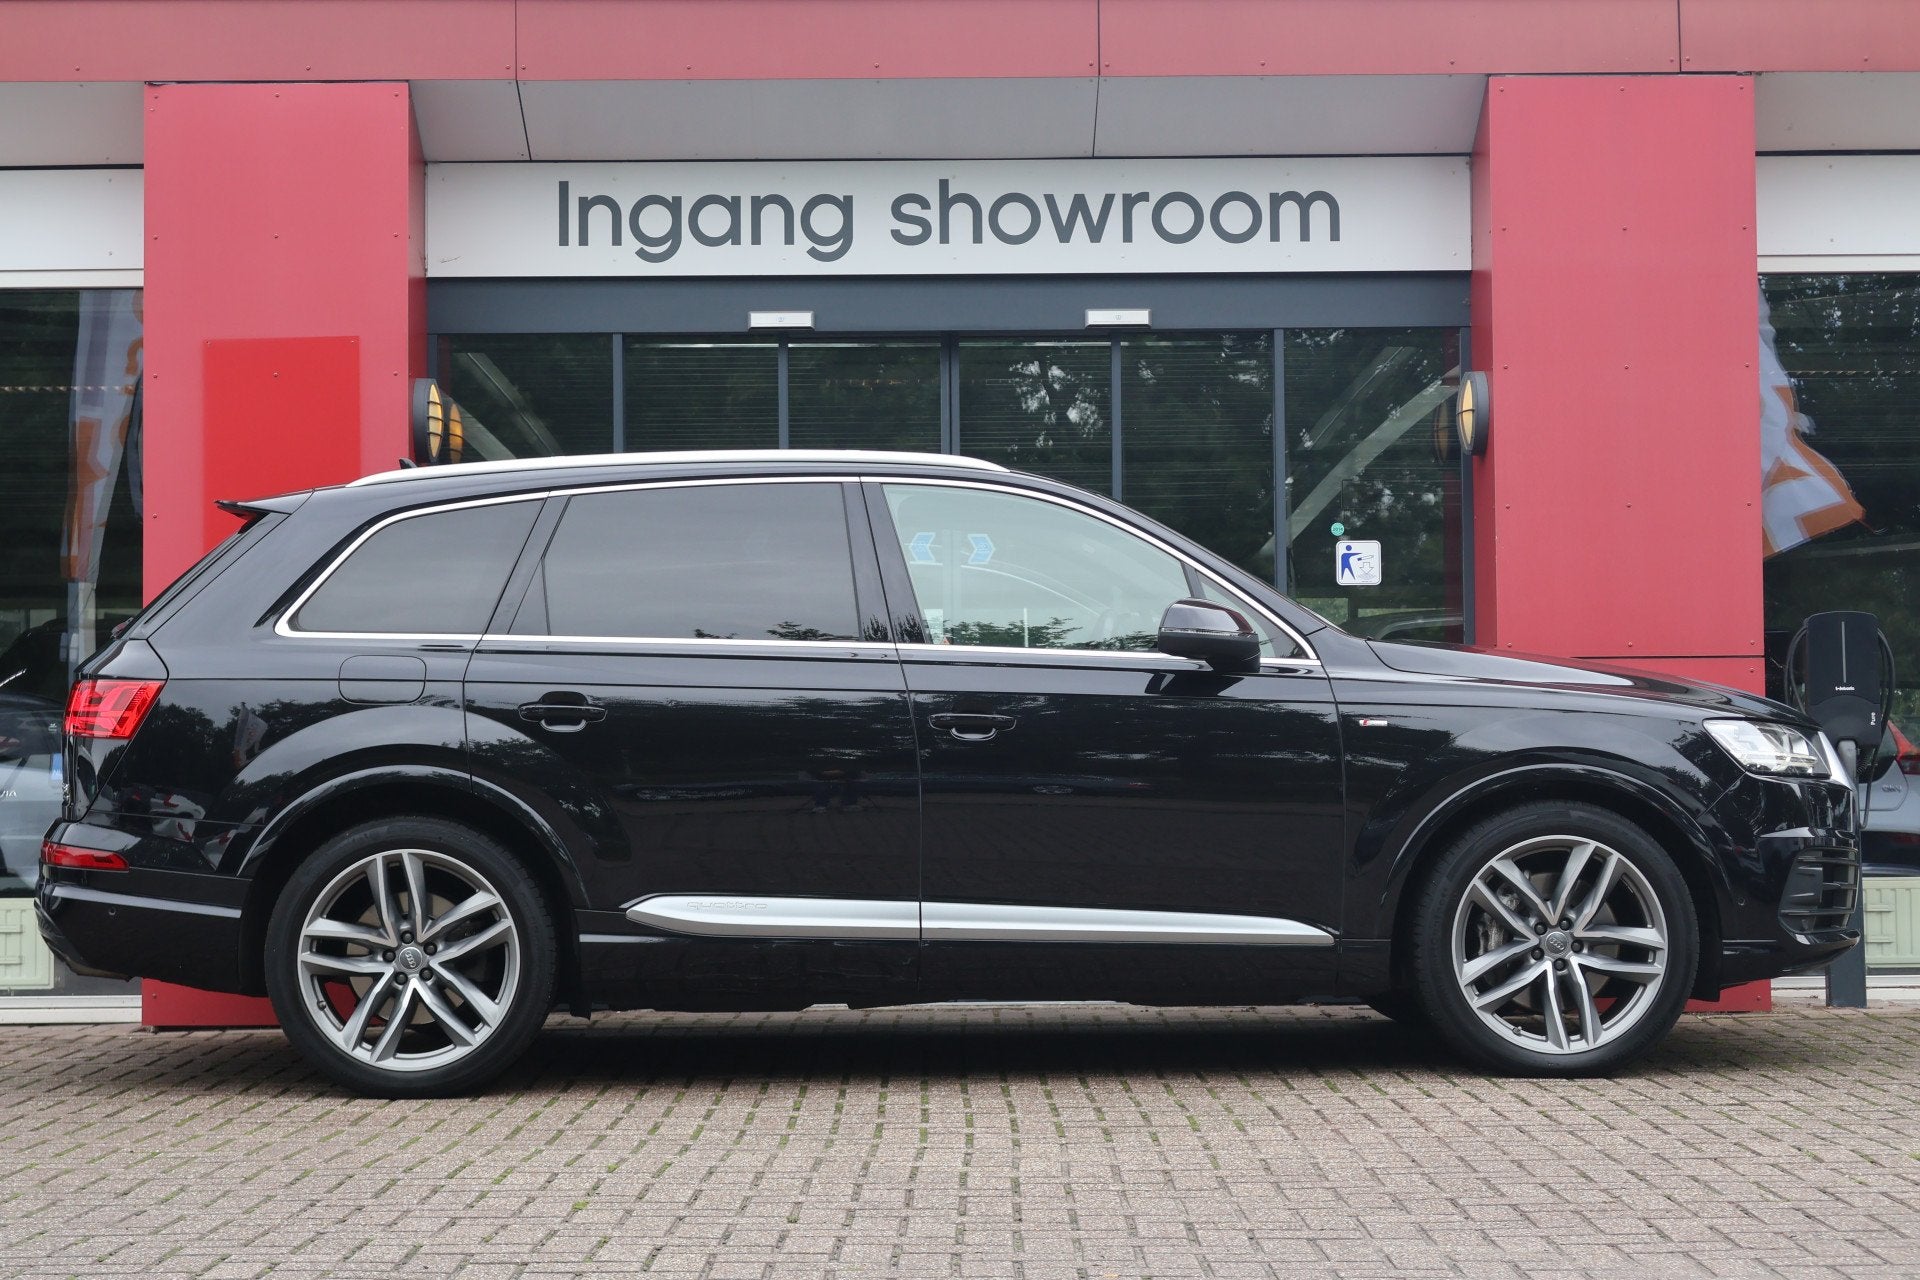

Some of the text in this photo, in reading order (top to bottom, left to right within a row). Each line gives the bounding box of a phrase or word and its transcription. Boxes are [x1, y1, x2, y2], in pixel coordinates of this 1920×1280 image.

[558, 178, 1341, 264] Ingang showroom
[686, 901, 769, 911] quattro
